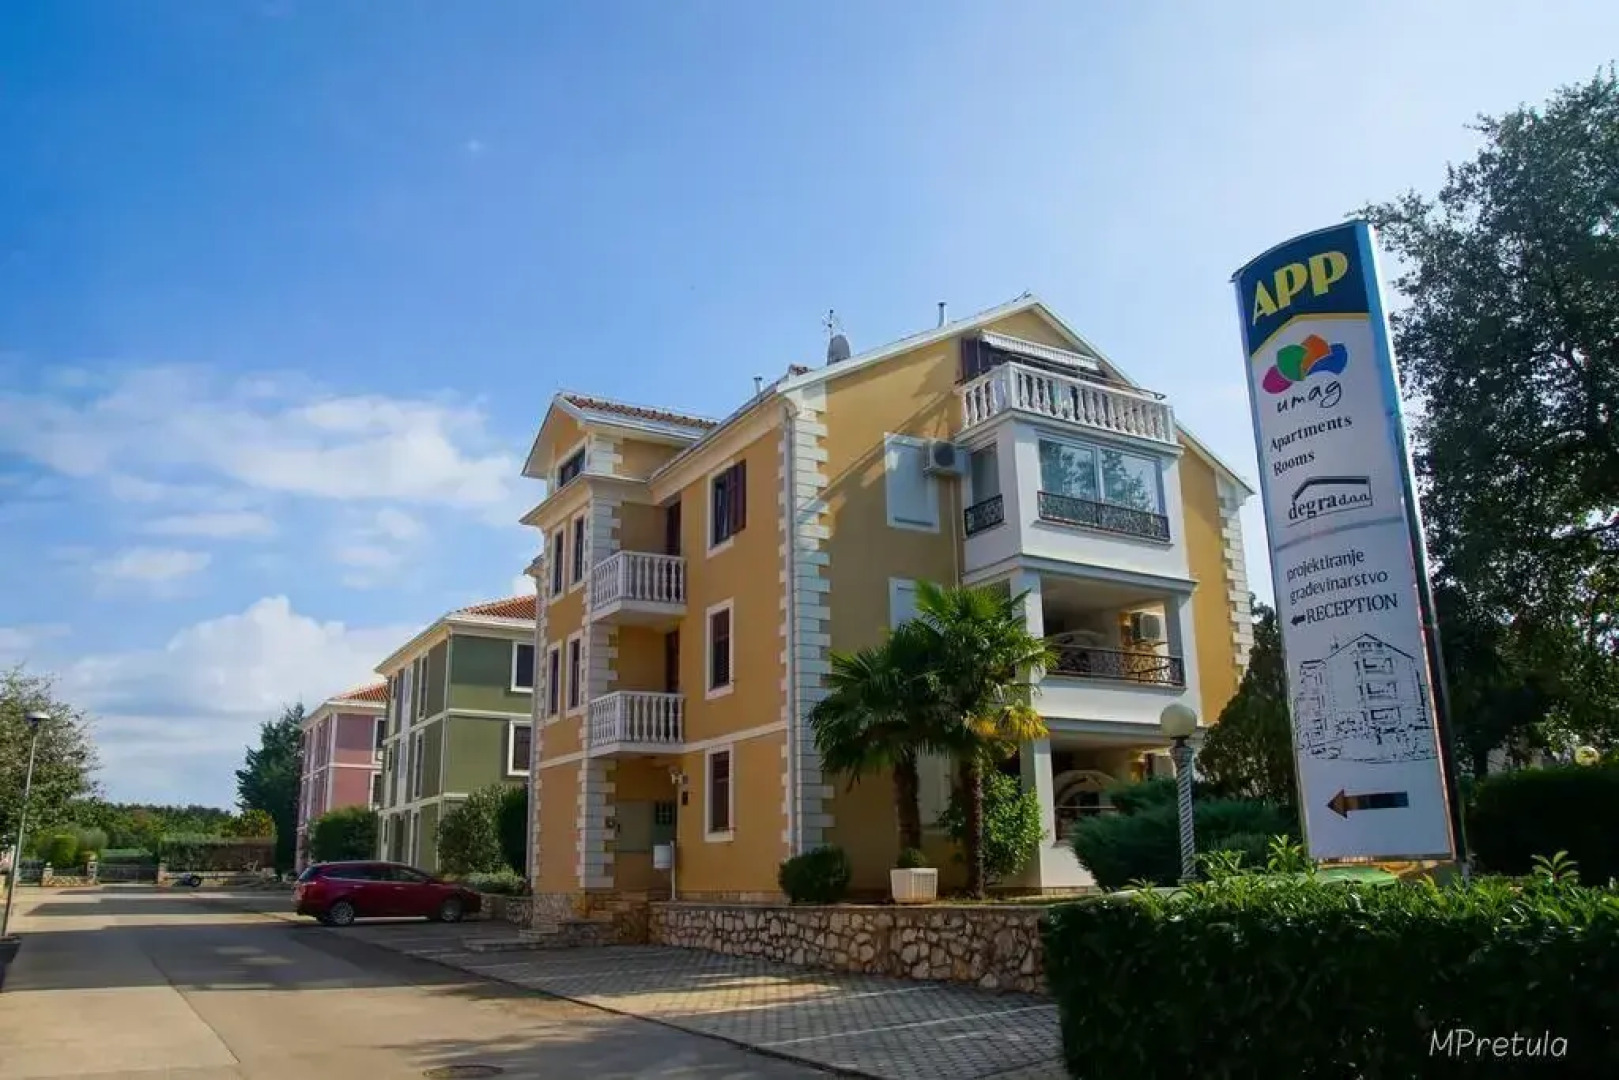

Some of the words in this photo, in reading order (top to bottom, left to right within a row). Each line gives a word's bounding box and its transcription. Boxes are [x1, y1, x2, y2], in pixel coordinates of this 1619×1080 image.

[1253, 251, 1348, 325] APP
[1277, 380, 1342, 413] umag
[1270, 416, 1353, 451] Apartments
[1273, 449, 1315, 475] Rooms
[1287, 549, 1364, 582] projektiranje
[1306, 593, 1398, 623] RECEPTION
